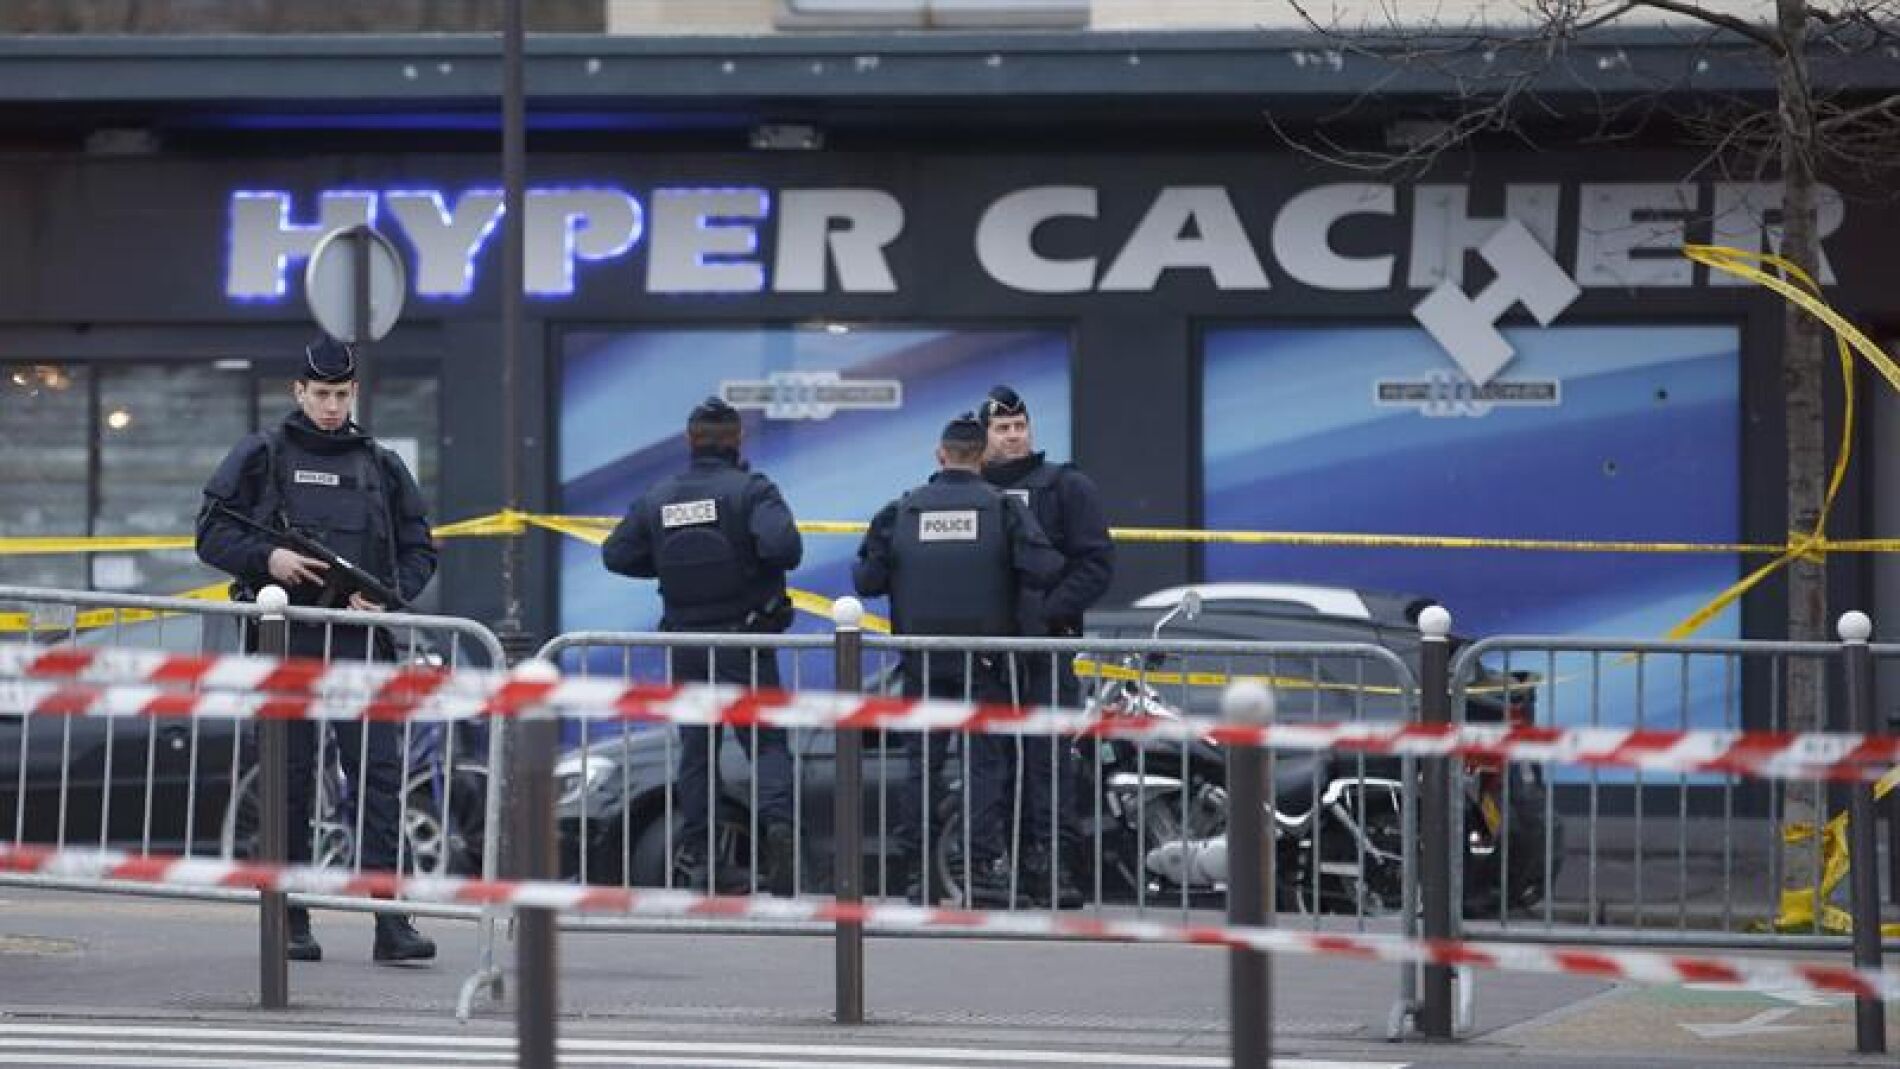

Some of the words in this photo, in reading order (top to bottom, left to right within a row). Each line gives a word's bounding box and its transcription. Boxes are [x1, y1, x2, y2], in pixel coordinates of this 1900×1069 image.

[226, 187, 905, 297] HYPER
[975, 184, 1845, 292] CACHER
[663, 502, 714, 522] POLICE
[924, 518, 972, 533] POLICE
